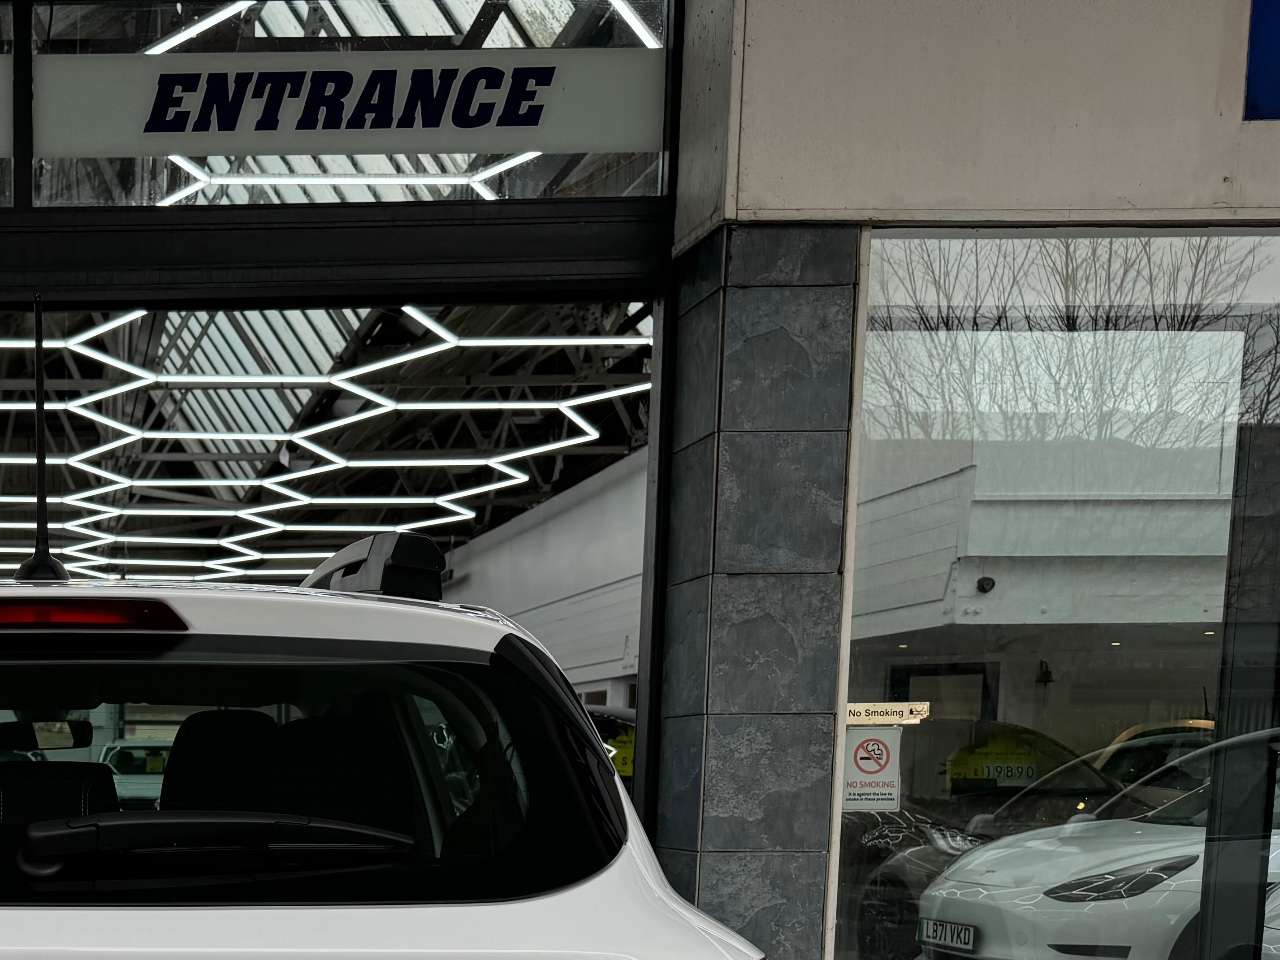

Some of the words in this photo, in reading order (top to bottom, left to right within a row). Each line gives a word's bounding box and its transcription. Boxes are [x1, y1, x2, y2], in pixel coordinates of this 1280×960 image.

[143, 66, 556, 133] ENTRANCE
[848, 709, 861, 717] No
[864, 708, 904, 718] Smoking
[846, 780, 858, 789] NO
[926, 922, 947, 942] LB71
[950, 925, 971, 945] VKD
